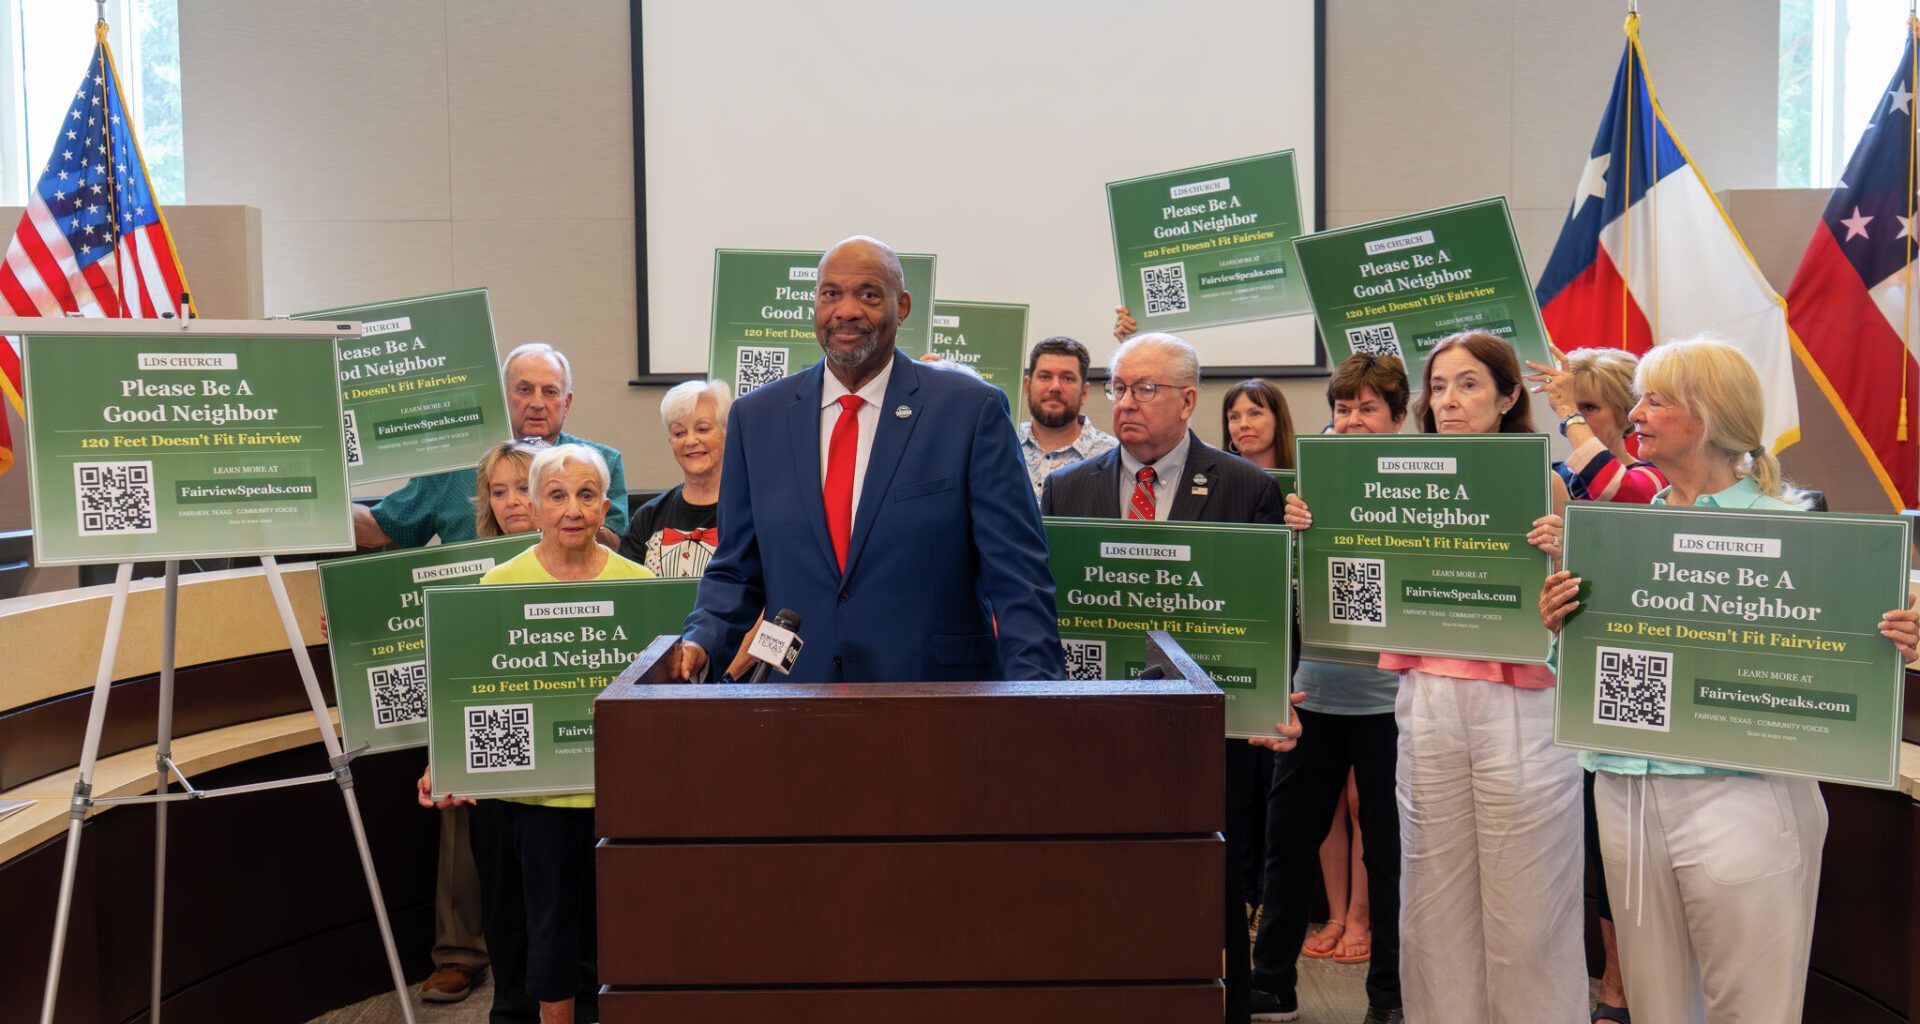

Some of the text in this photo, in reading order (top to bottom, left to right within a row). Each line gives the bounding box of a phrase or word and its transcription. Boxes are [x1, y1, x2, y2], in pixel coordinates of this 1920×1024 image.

[1174, 182, 1220, 196] LDS CHURCH
[1162, 196, 1241, 219] Please Be A
[1154, 213, 1257, 238] Good Neighbor
[1161, 245, 1180, 255] Feet
[1182, 239, 1216, 251] Doesn't
[1218, 237, 1231, 246] Fit
[1233, 231, 1274, 243] Fairview
[1370, 236, 1423, 252] LDS CHURCH
[1359, 250, 1451, 277] Please Be A
[1202, 268, 1282, 285] FairviewSpeaks.com
[1354, 269, 1472, 298] Good Neighbor
[776, 287, 815, 300] Pleas
[1346, 287, 1494, 318] 120 Feet Doesn't Fit Fairview
[761, 306, 803, 319] Good
[765, 328, 787, 337] Feet
[791, 329, 816, 338] Does
[934, 333, 967, 346] Be A
[339, 337, 426, 361] lease Be A
[144, 358, 222, 366] LDS CHURCH
[341, 356, 446, 380] od Neighbor
[121, 379, 253, 396] Please Be A
[352, 384, 395, 398] Doesn't
[398, 381, 414, 391] Fit
[417, 375, 467, 388] Fairview
[104, 404, 277, 425] Good Neighbor
[378, 414, 479, 434] FairviewSpeaks.com
[83, 433, 301, 447] 120 Feet Doesn't Fit Fairview
[1382, 462, 1444, 470] LDS CHURCH
[182, 484, 312, 497] FairviewSpeaks.com
[1364, 482, 1469, 499] Please Be A
[1351, 507, 1489, 528] Good Neighbor
[1335, 535, 1510, 550] 120 Feet Doesn't Fit Fairview
[1679, 539, 1763, 552] LDS CHURCH
[1106, 547, 1176, 557] LDS CHURCH
[418, 564, 483, 579] LDS CHURCH
[1084, 566, 1203, 586] Please Be A
[1653, 562, 1795, 589] Please Be A
[1068, 589, 1225, 613] Good Neighbor
[1406, 587, 1516, 602] FairviewSpeaks.com
[530, 606, 600, 616] LDS CHURCH
[1631, 589, 1820, 620] Good Neighbor
[388, 617, 425, 631] Goo
[1075, 617, 1103, 628] Feet
[1107, 618, 1159, 631] Doesn't
[1163, 621, 1181, 632] Fit
[1186, 622, 1246, 635] Fairview
[508, 626, 628, 645] Please Be A
[1607, 622, 1846, 651] 120 Feet Doesn't Fit Fairview
[372, 640, 425, 655] 120 Feet
[758, 637, 783, 653] TEXAS
[492, 648, 638, 669] Good Neighbo
[473, 684, 495, 693] 120
[500, 681, 529, 692] Feet
[533, 678, 585, 690] Doesn't
[590, 676, 607, 687] Fit
[1738, 669, 1813, 683] LEARN MORE AT
[1700, 686, 1849, 712] FairviewSpeaks.com
[1730, 716, 1752, 725] TEXAS
[1757, 719, 1800, 730] COMMUNITY
[1802, 724, 1828, 733] VOICES
